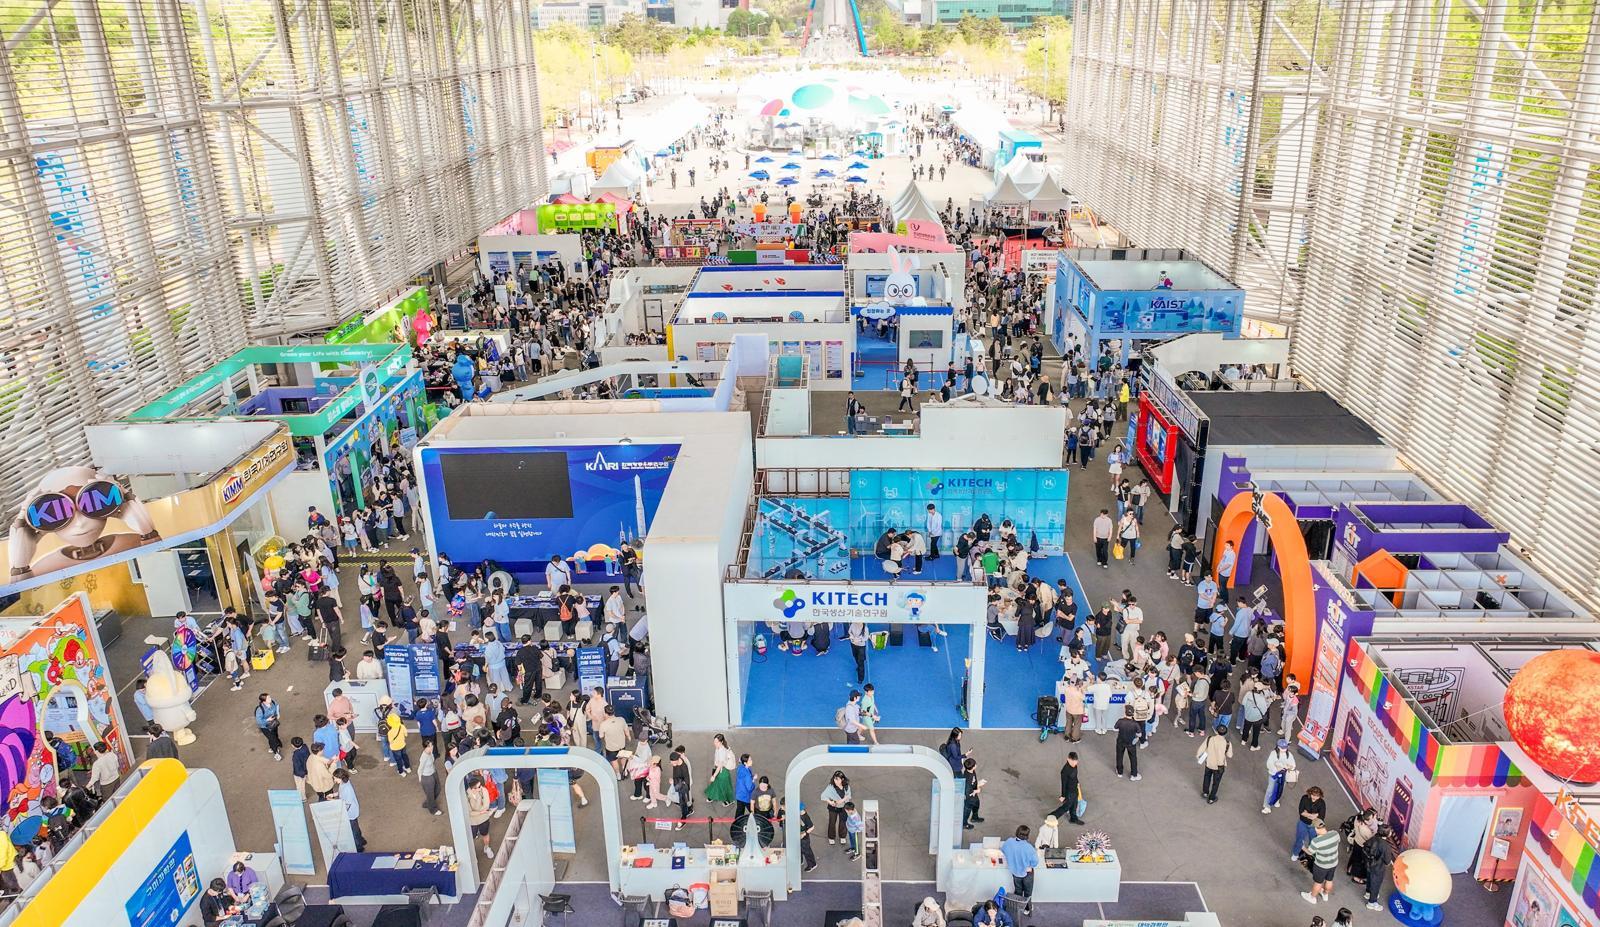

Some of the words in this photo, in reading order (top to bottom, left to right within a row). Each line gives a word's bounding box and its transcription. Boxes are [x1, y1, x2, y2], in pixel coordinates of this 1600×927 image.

[1150, 300, 1187, 309] KAIST
[585, 451, 619, 471] KARI
[222, 477, 244, 502] KIMM
[948, 478, 993, 487] KITECH
[27, 483, 123, 528] KIMM
[812, 591, 888, 606] KITECH
[812, 608, 888, 618] 한국생산기술연구원
[145, 858, 176, 897] 구미과학관
